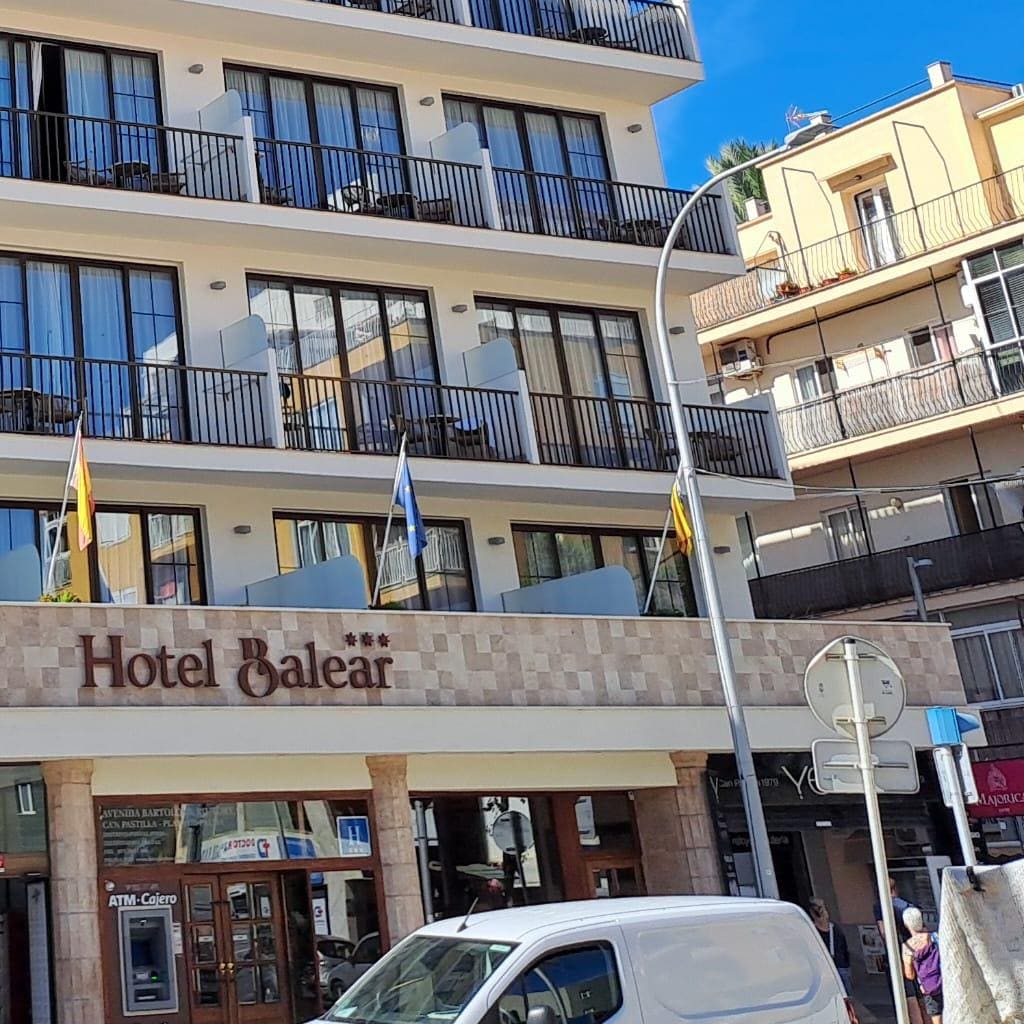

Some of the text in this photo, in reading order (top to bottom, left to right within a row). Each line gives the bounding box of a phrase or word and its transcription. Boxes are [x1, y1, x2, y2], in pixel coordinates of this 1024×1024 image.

[79, 634, 393, 698] Hotel Balear
[102, 807, 141, 818] AVENIDA
[121, 820, 158, 829] PASTILLA
[348, 825, 361, 845] H
